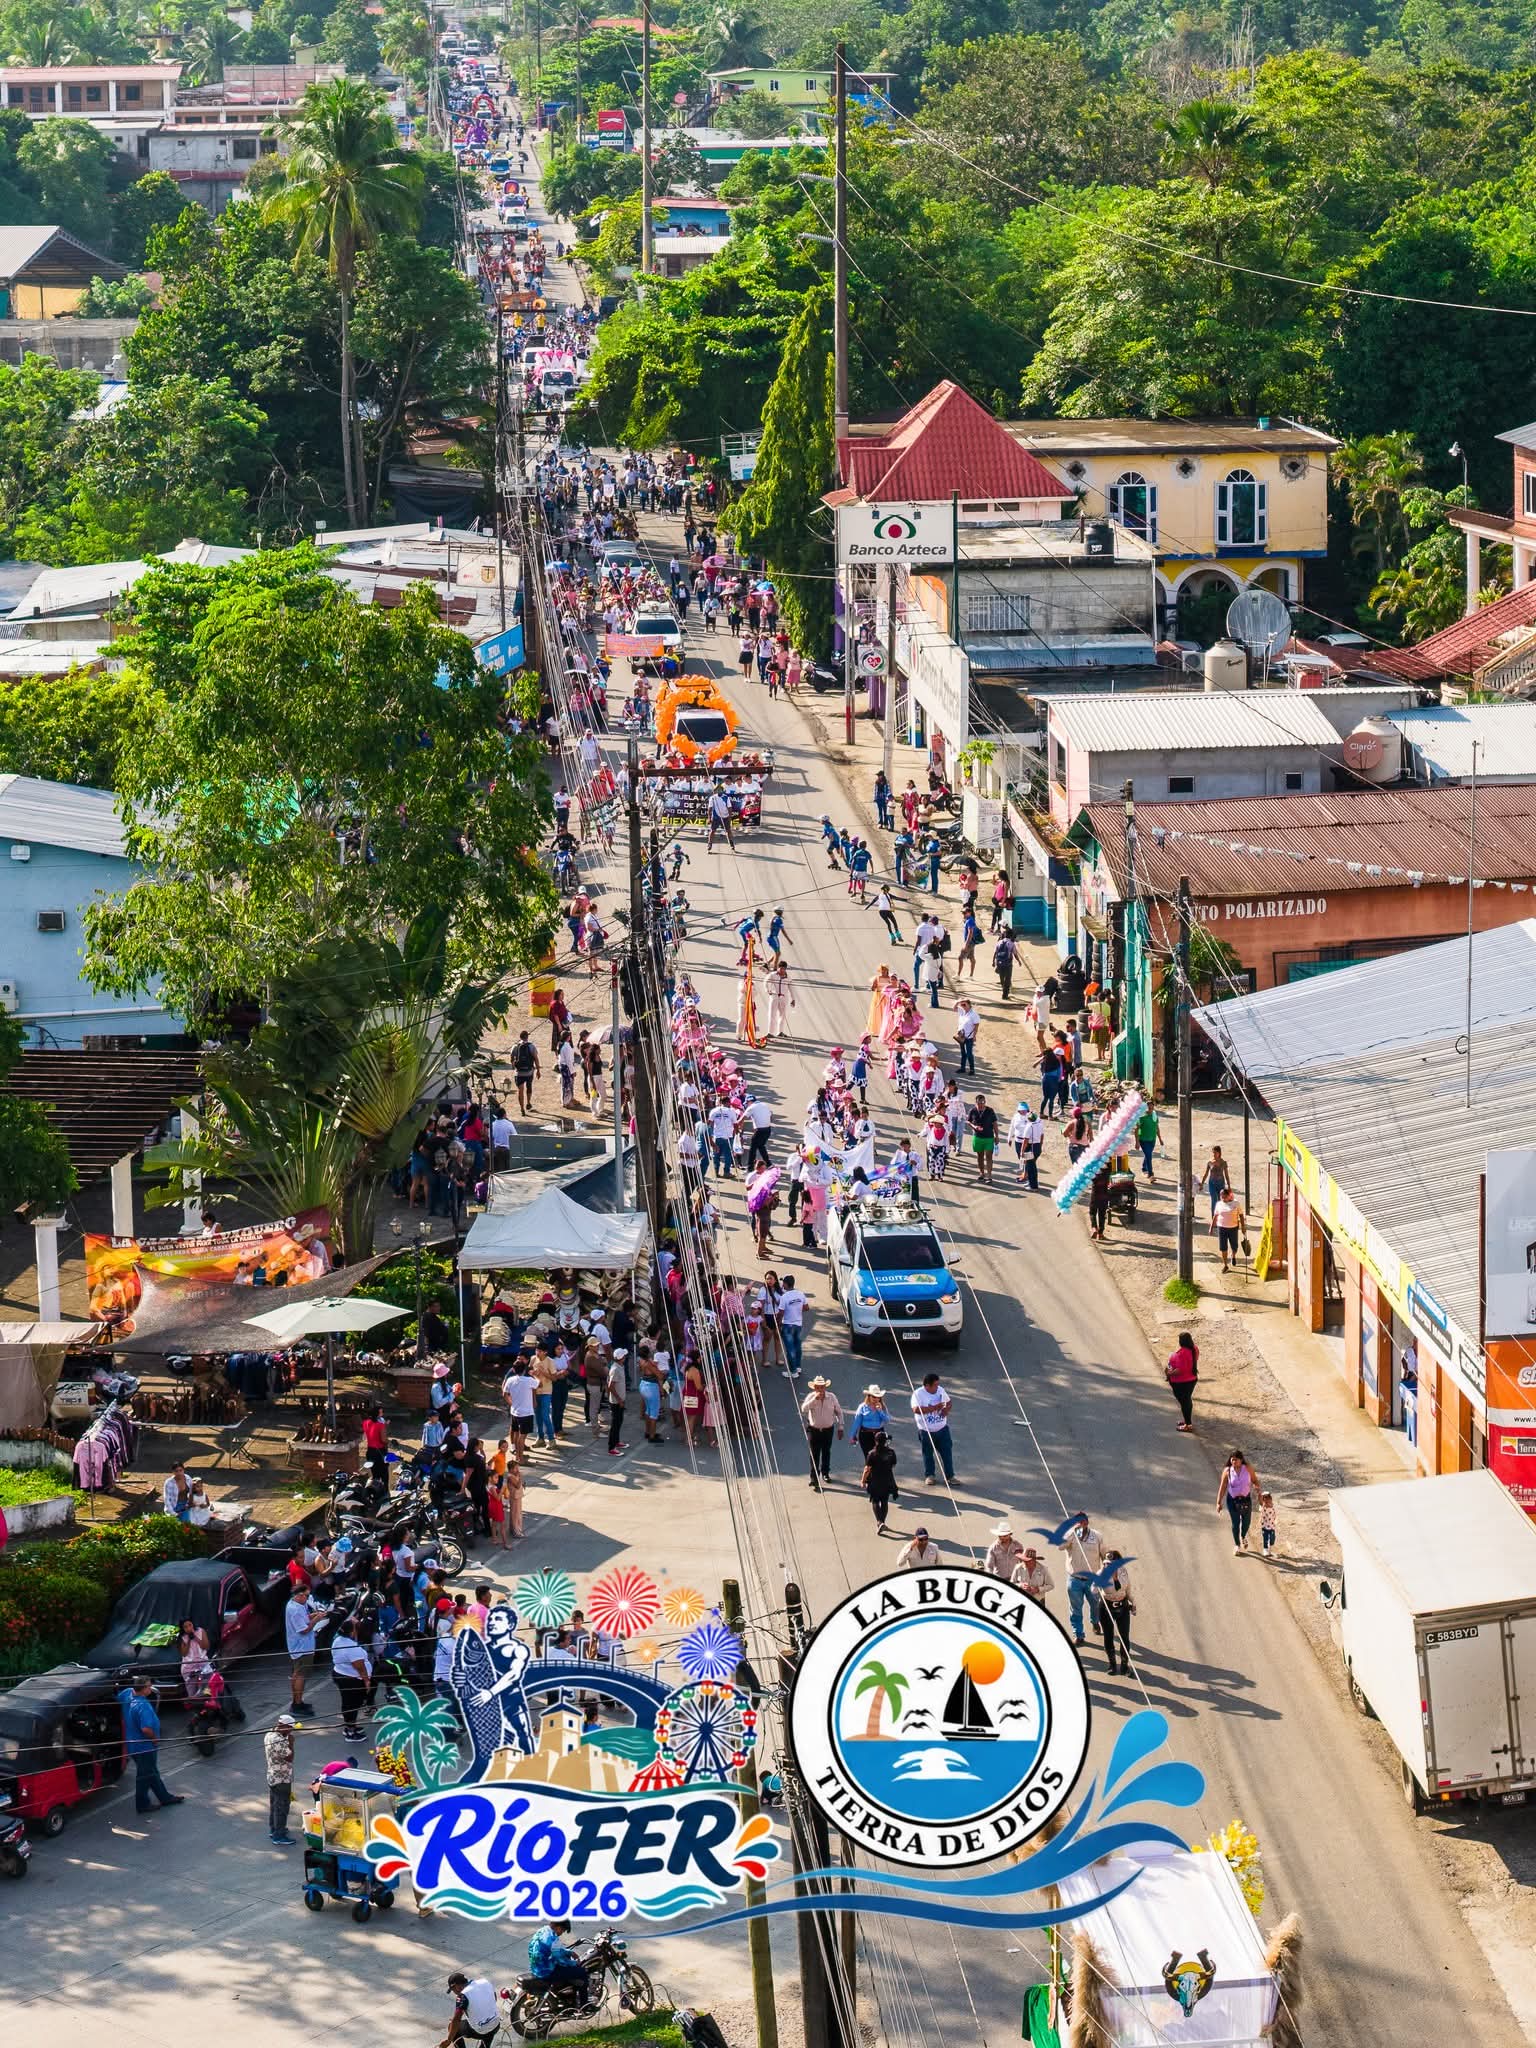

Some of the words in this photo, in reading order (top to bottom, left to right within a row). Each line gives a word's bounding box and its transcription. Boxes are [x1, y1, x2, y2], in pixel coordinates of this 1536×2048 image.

[849, 544, 894, 556] Banco
[897, 543, 947, 556] Azteca
[1350, 742, 1373, 751] Claro
[1017, 841, 1025, 880] OTEL
[1190, 904, 1220, 921] UTO
[1225, 898, 1328, 920] POLARIZADO
[111, 1236, 133, 1249] LA
[1426, 1633, 1435, 1643] C
[1437, 1627, 1478, 1641] 583BYD
